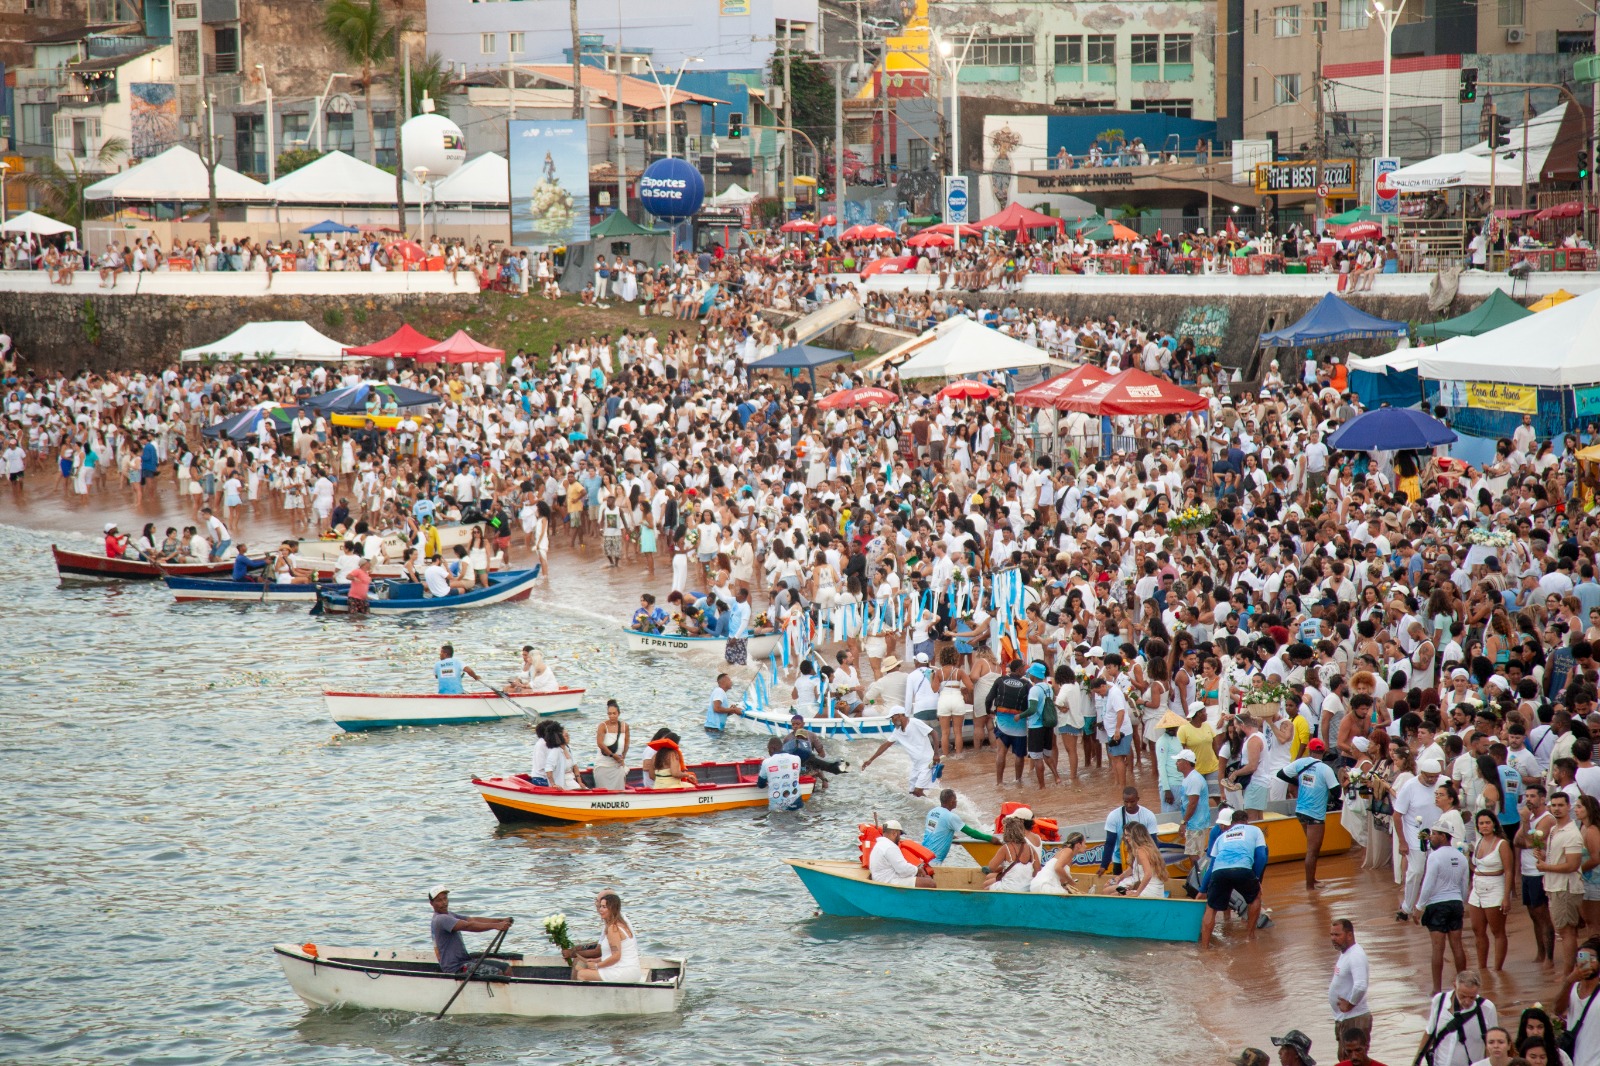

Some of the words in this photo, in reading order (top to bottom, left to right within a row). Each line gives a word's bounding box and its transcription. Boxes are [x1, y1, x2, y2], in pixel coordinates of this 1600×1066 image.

[641, 177, 686, 188] Esportes
[1111, 172, 1135, 185] HOTEL
[1269, 167, 1290, 188] THE
[1292, 166, 1317, 188] BEST
[642, 188, 652, 197] da
[653, 188, 682, 199] Sorte
[1350, 224, 1377, 234] BRAHMA
[854, 391, 884, 401] BRAHMA
[651, 639, 668, 648] PRA
[668, 641, 689, 649] TUDO
